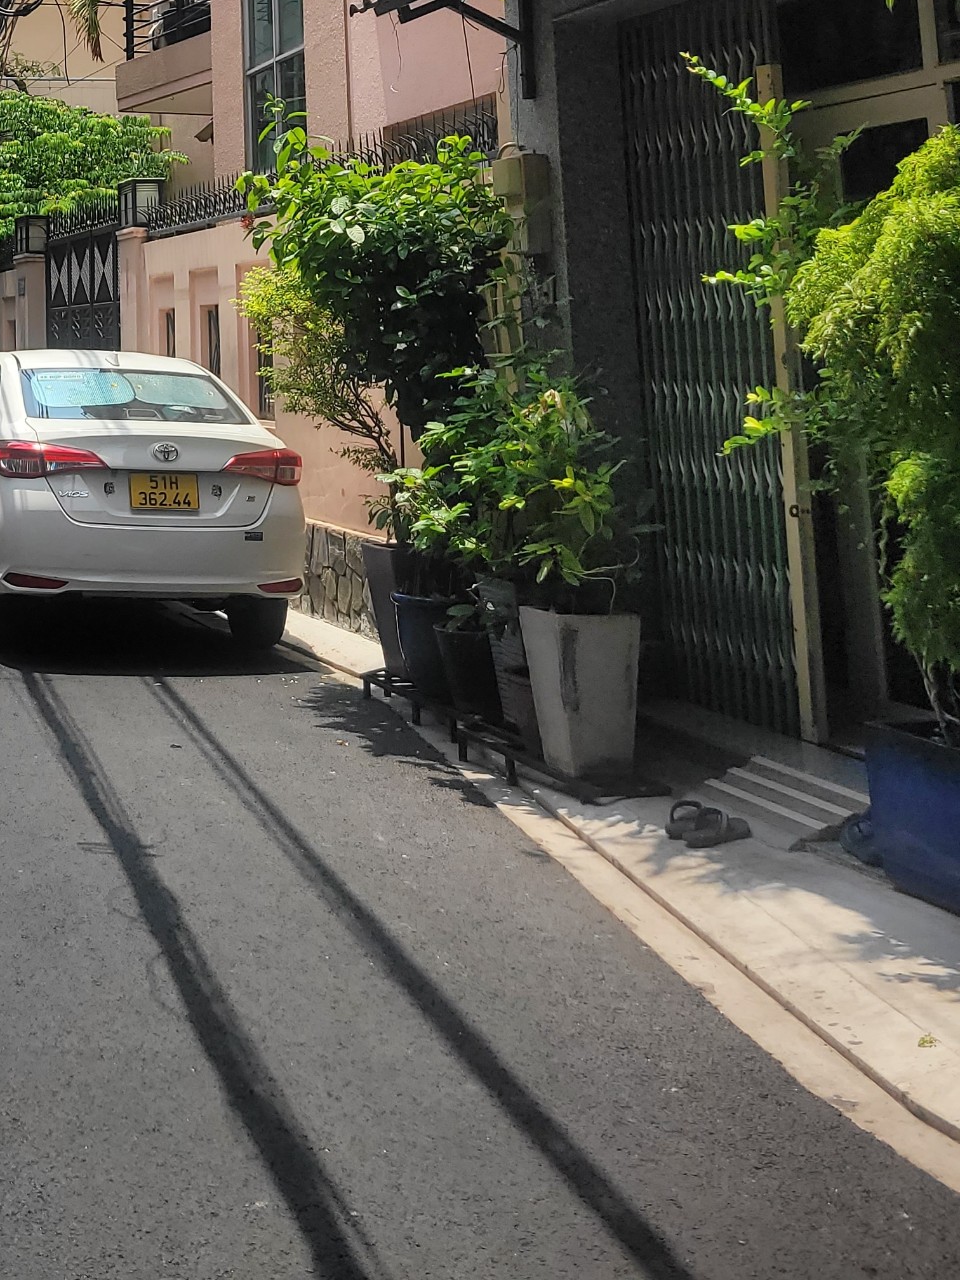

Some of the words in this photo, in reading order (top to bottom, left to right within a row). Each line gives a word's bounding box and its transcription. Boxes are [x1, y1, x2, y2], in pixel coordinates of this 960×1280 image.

[148, 475, 179, 491] 51H
[58, 489, 89, 498] VIOS
[138, 491, 192, 507] 362.44
